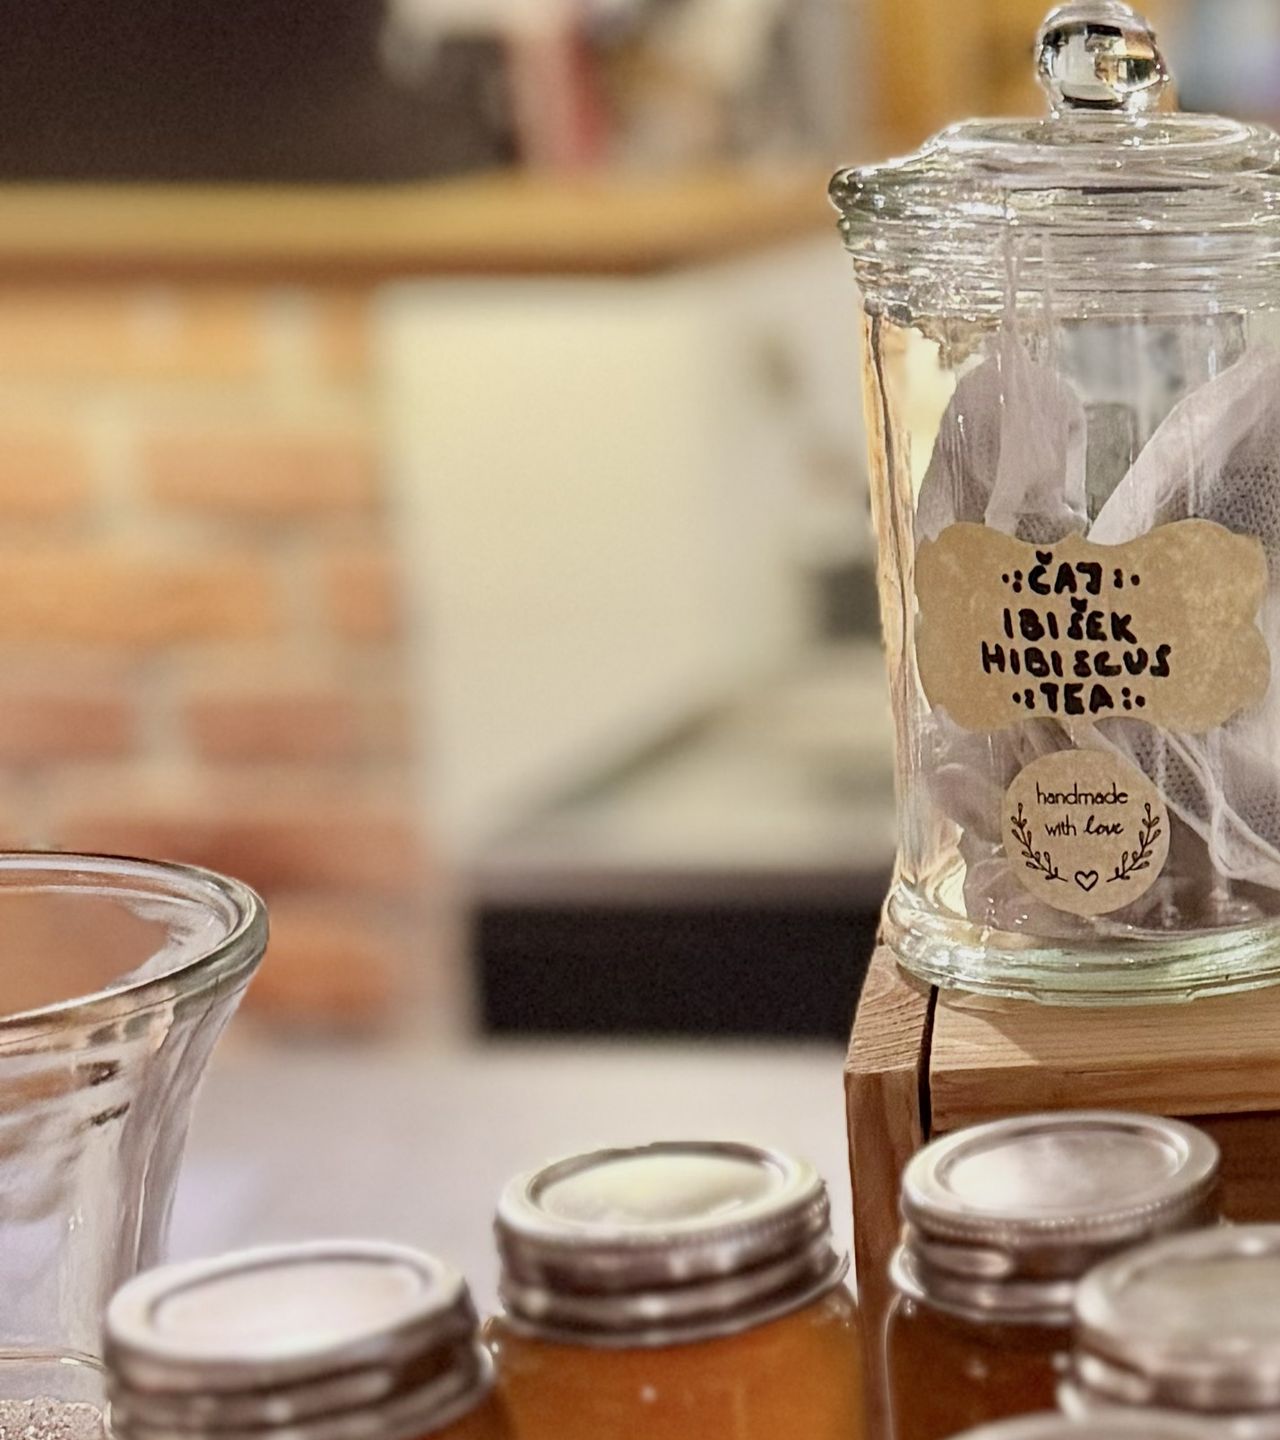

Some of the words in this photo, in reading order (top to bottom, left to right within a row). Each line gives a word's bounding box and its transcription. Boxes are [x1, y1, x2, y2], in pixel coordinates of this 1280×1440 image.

[1002, 597, 1139, 645] IBIŠEK
[980, 640, 1173, 678] HIBISCUS
[1035, 782, 1129, 806] handmade
[1044, 818, 1078, 838] with
[1083, 816, 1125, 837] love
